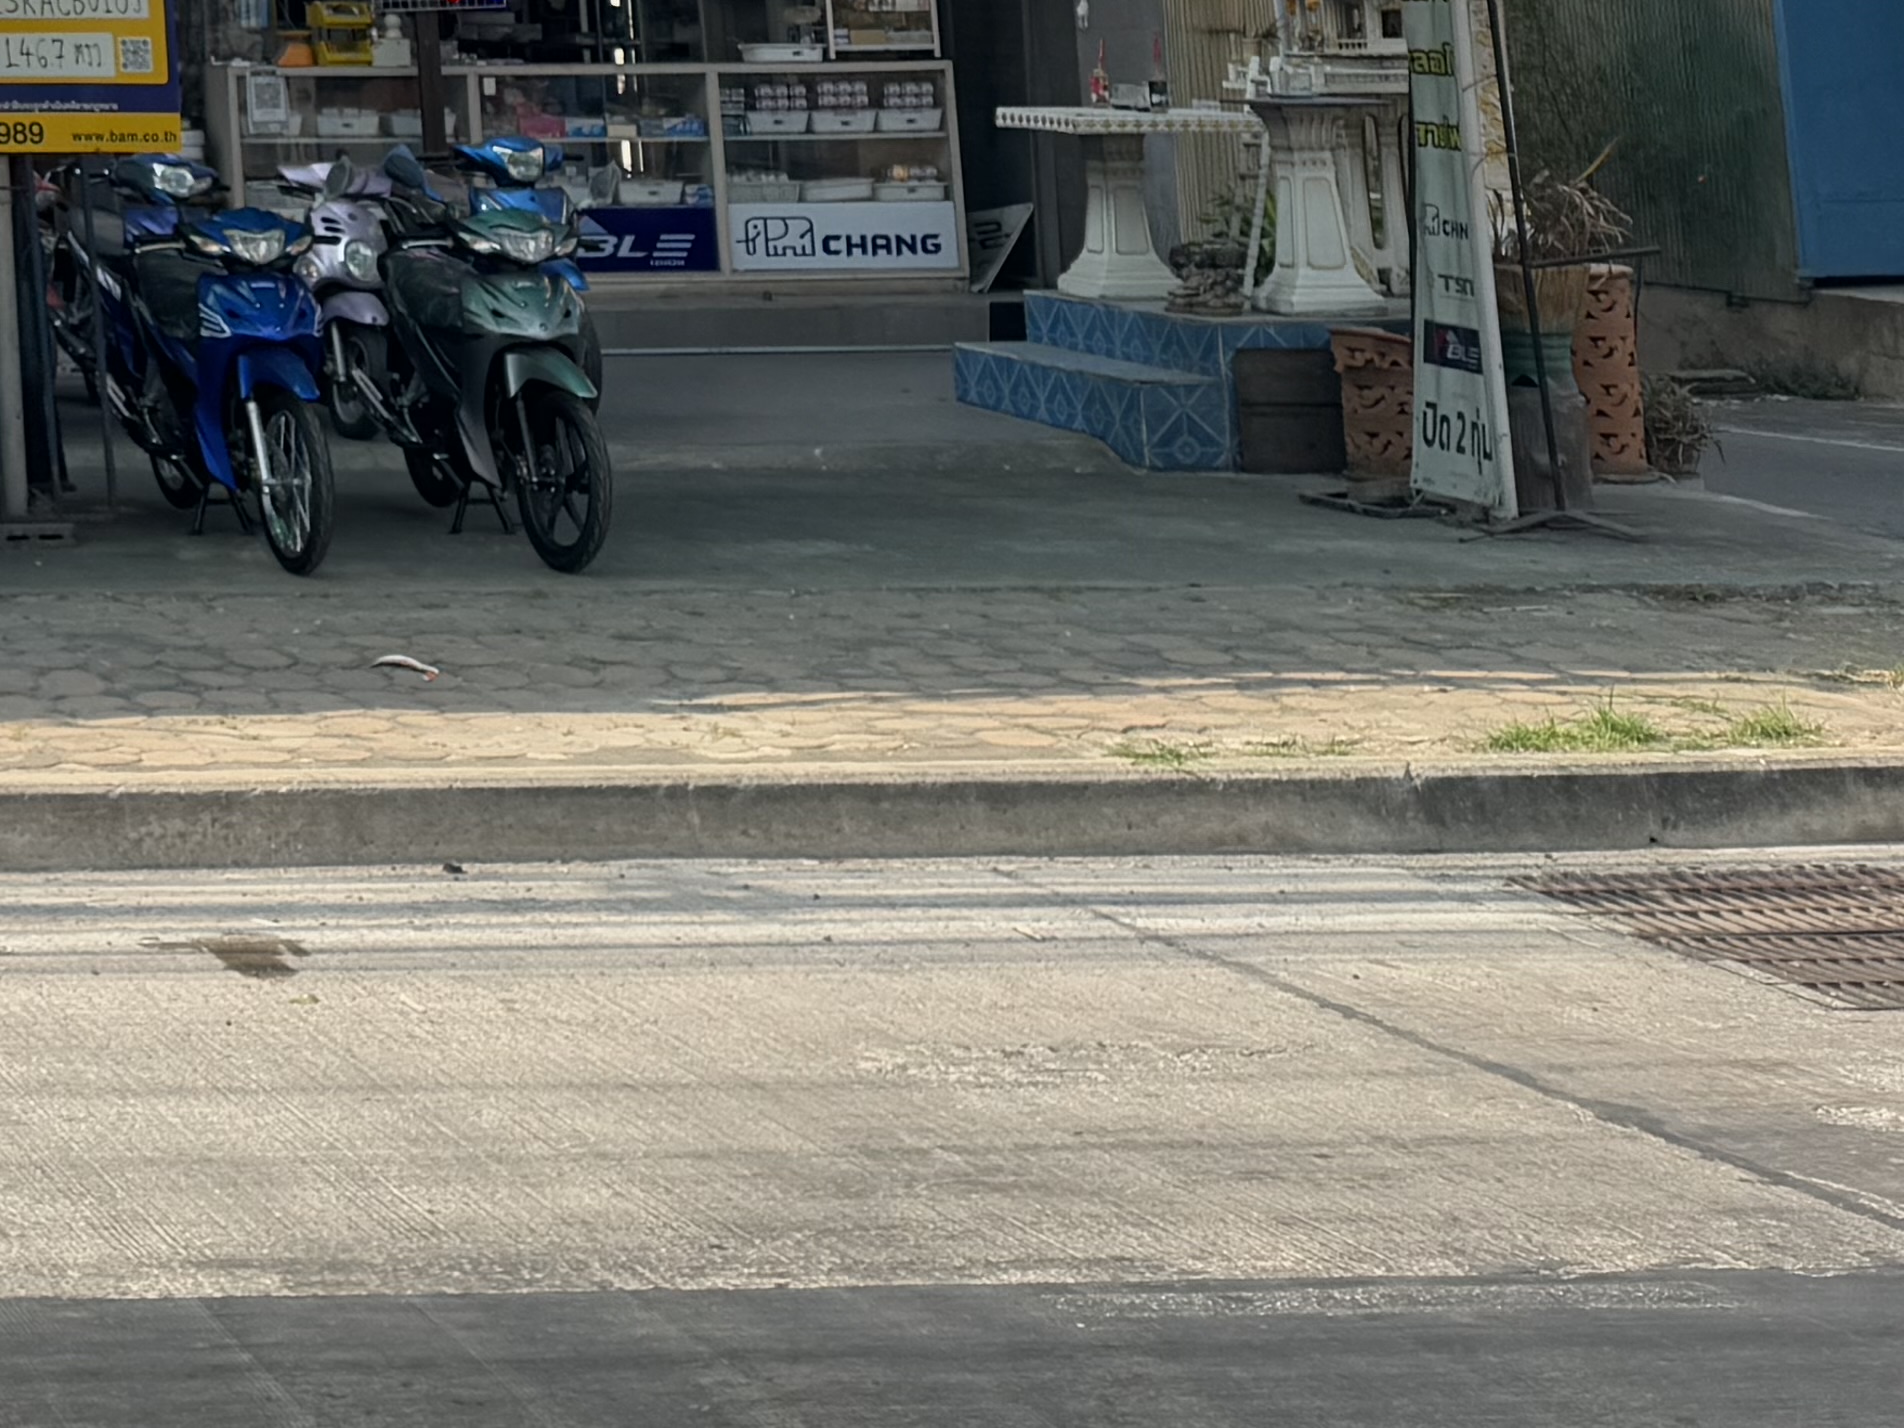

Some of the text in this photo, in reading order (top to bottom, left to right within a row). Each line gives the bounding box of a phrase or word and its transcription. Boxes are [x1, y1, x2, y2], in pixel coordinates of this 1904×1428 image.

[72, 129, 177, 144] www.bam.co.th
[822, 234, 943, 257] CHANG
[1455, 408, 1467, 446] 2
